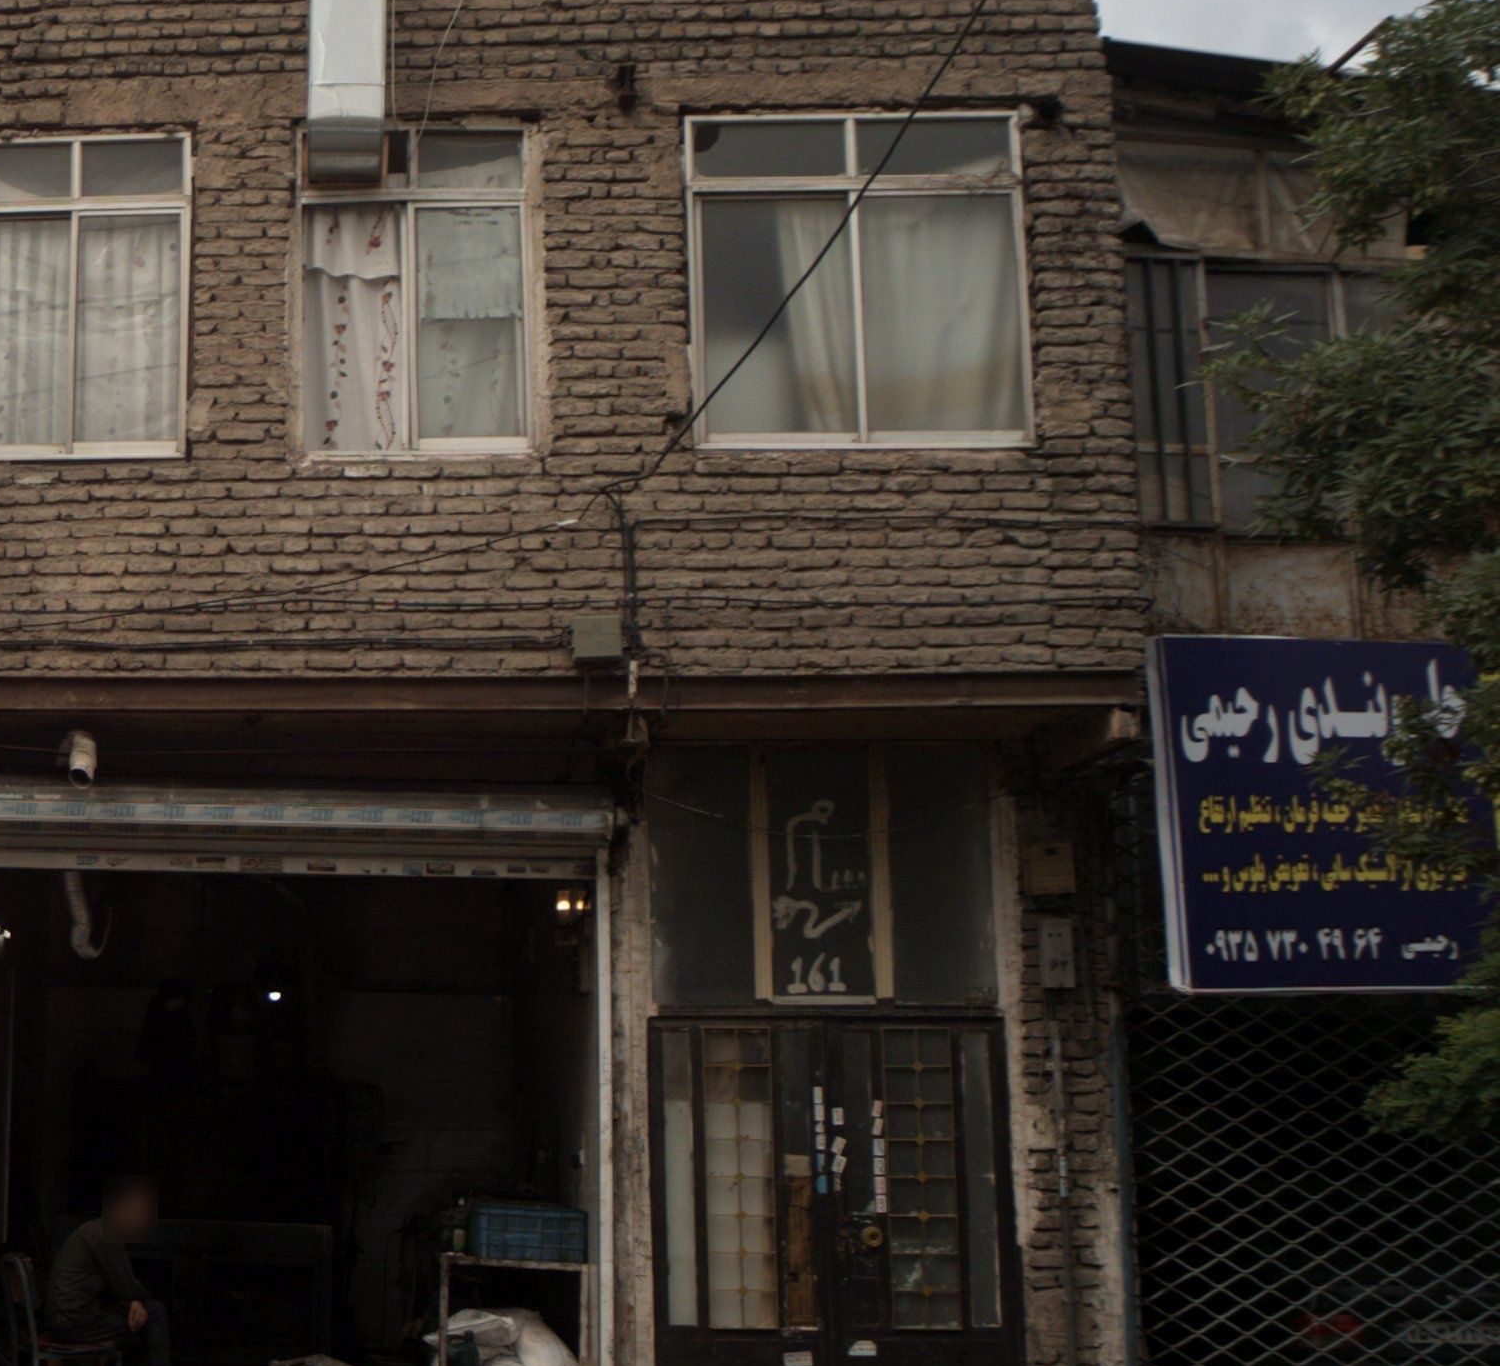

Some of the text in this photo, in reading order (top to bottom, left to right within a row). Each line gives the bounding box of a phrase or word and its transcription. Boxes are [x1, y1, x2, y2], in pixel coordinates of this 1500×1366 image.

[1180, 686, 1279, 763] رحیمی
[1199, 794, 1237, 834] ارتفاع
[1238, 794, 1272, 833] تنظیم
[1232, 852, 1266, 893] پلوس
[1268, 853, 1310, 893] تعویض
[1204, 927, 1460, 962] رحیمی ۰۹۳۵ ۷۳۰ ۴۹ ۶۴
[786, 951, 847, 994] 161
